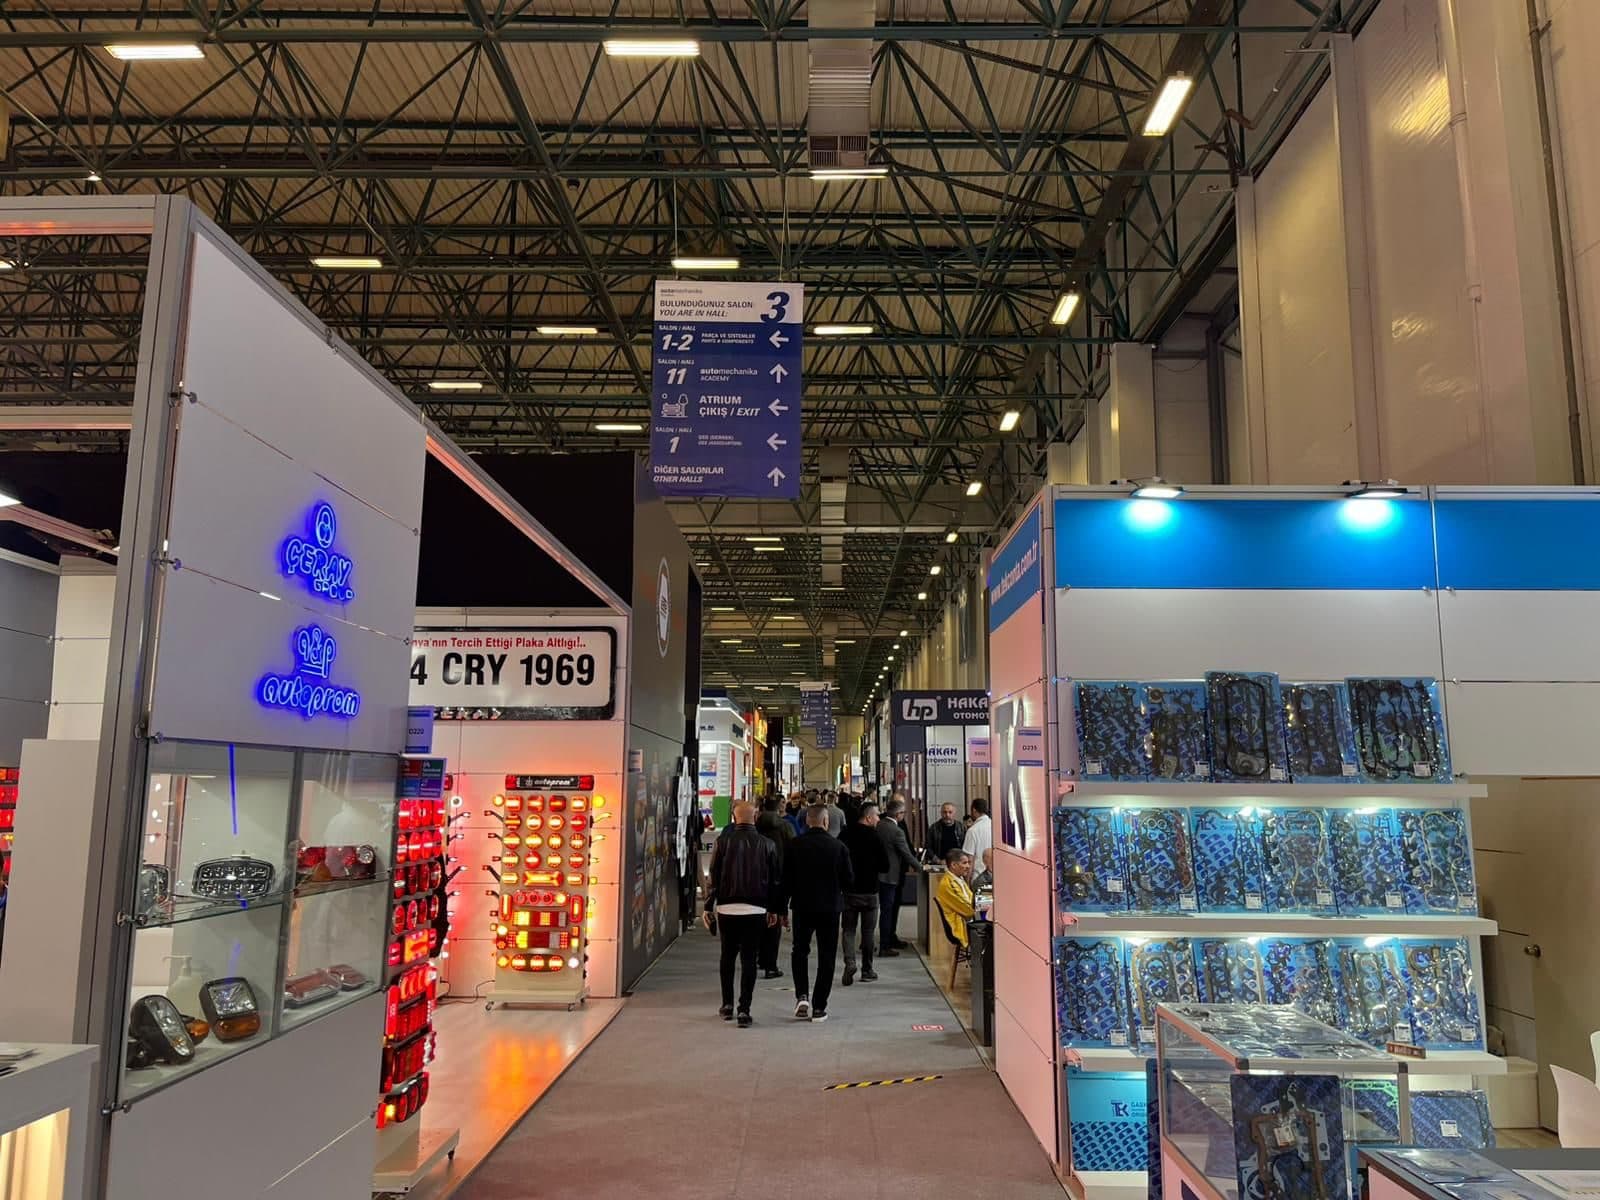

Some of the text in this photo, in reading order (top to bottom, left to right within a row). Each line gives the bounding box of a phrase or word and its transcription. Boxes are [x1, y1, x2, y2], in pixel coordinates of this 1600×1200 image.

[760, 291, 790, 323] 3
[659, 309, 676, 317] YOU
[677, 309, 694, 317] ARE
[662, 334, 694, 351] 1-2
[700, 367, 758, 375] automechanika
[666, 368, 688, 385] 11
[700, 395, 742, 404] ATRIUM
[699, 407, 728, 418] ÇIKIŞ
[736, 408, 760, 416] EXIT
[670, 436, 680, 453] 1
[680, 466, 724, 475] SALONLAR
[653, 475, 678, 483] OTHER
[450, 638, 482, 648] Tercih
[515, 638, 544, 648] Plaka
[410, 651, 595, 686] 4 CRY 1969
[907, 697, 988, 720] hp HAKA
[928, 747, 957, 756] AKAN
